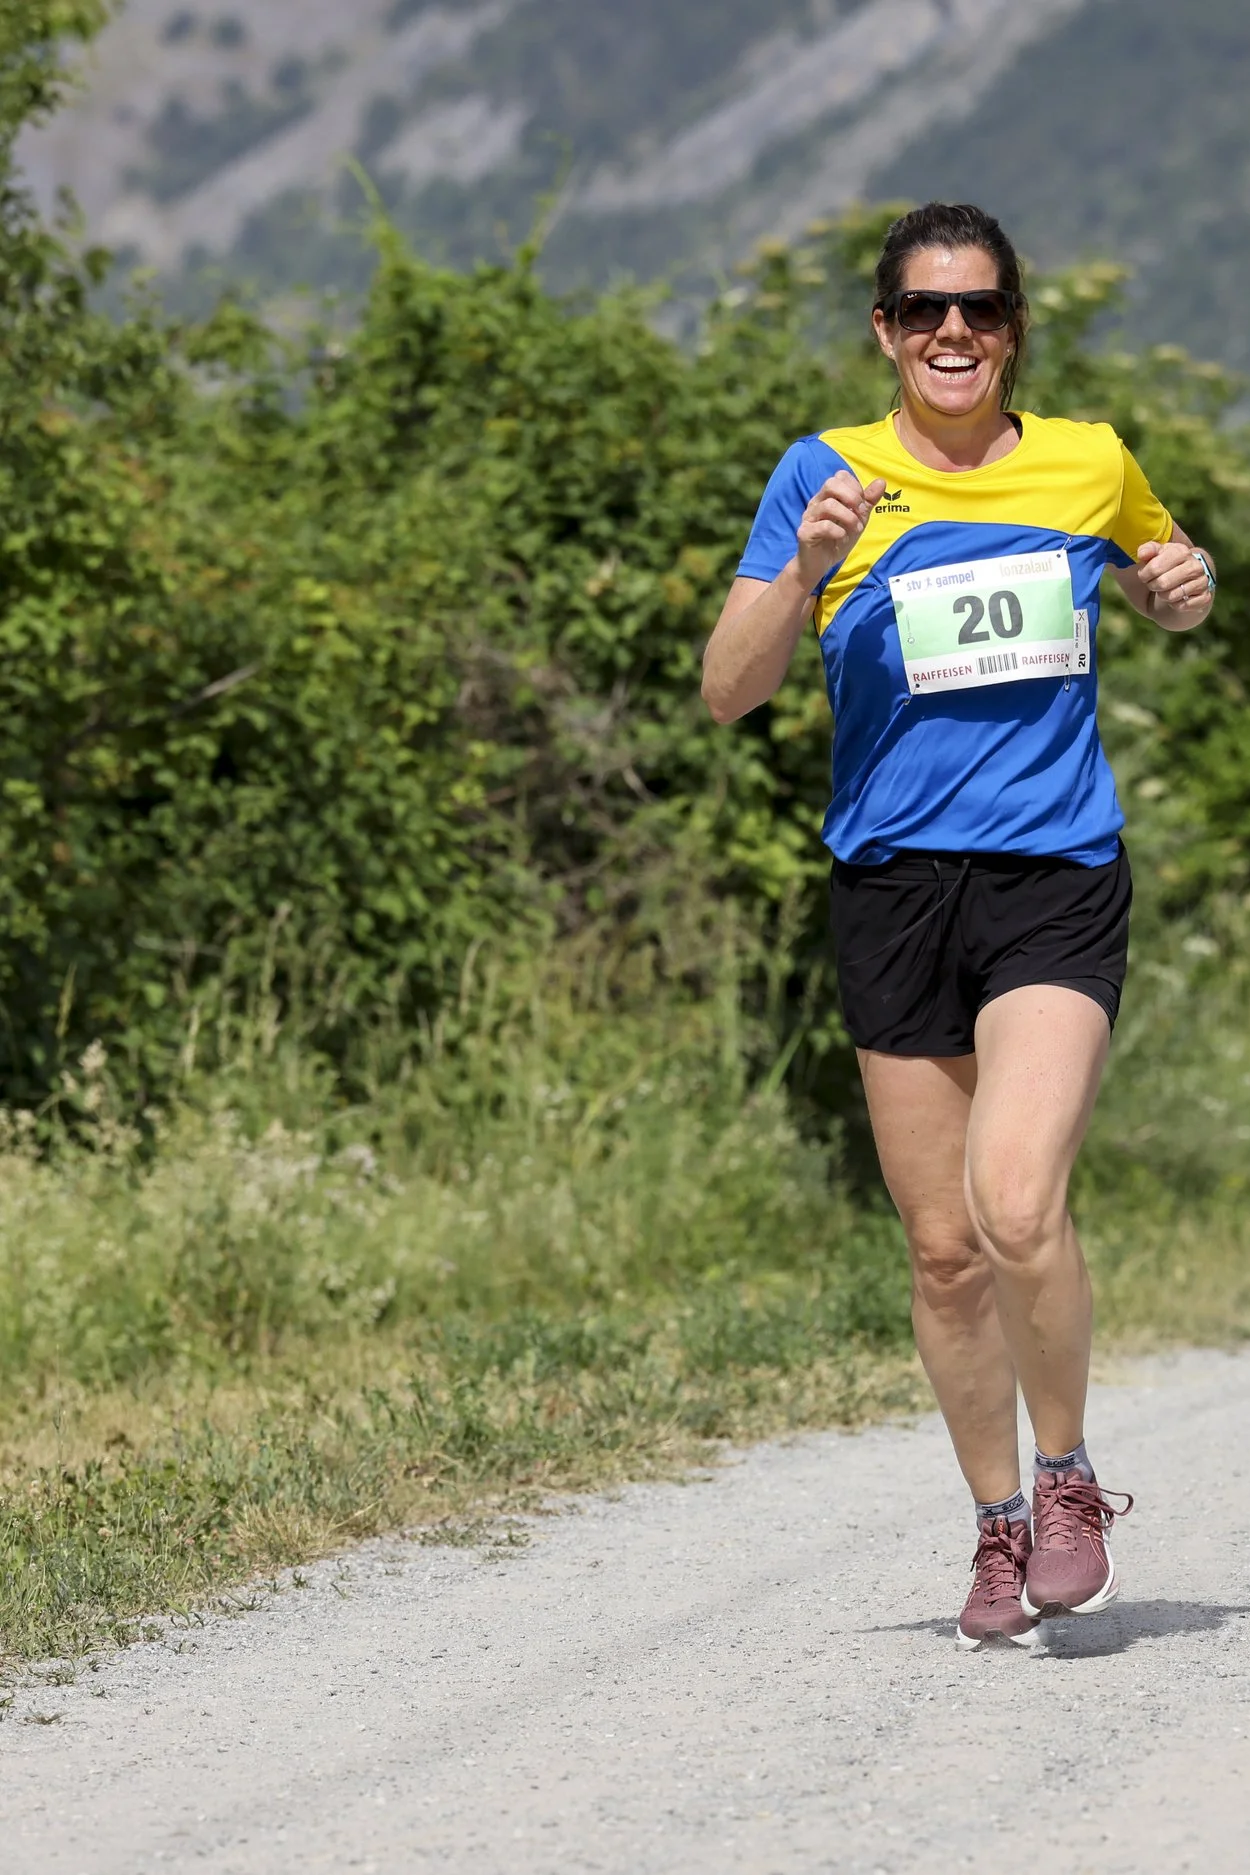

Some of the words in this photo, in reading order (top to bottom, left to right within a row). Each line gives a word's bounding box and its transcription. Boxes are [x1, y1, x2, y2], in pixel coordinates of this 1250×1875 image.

[875, 503, 910, 513] erima
[906, 579, 922, 592] stv
[936, 570, 975, 588] gampel
[999, 557, 1053, 578] lonzalauf
[952, 590, 1024, 645] 20
[913, 665, 972, 682] RAIFFEISEN
[1022, 653, 1070, 665] RAIFFEISEN
[1078, 653, 1086, 668] 20
